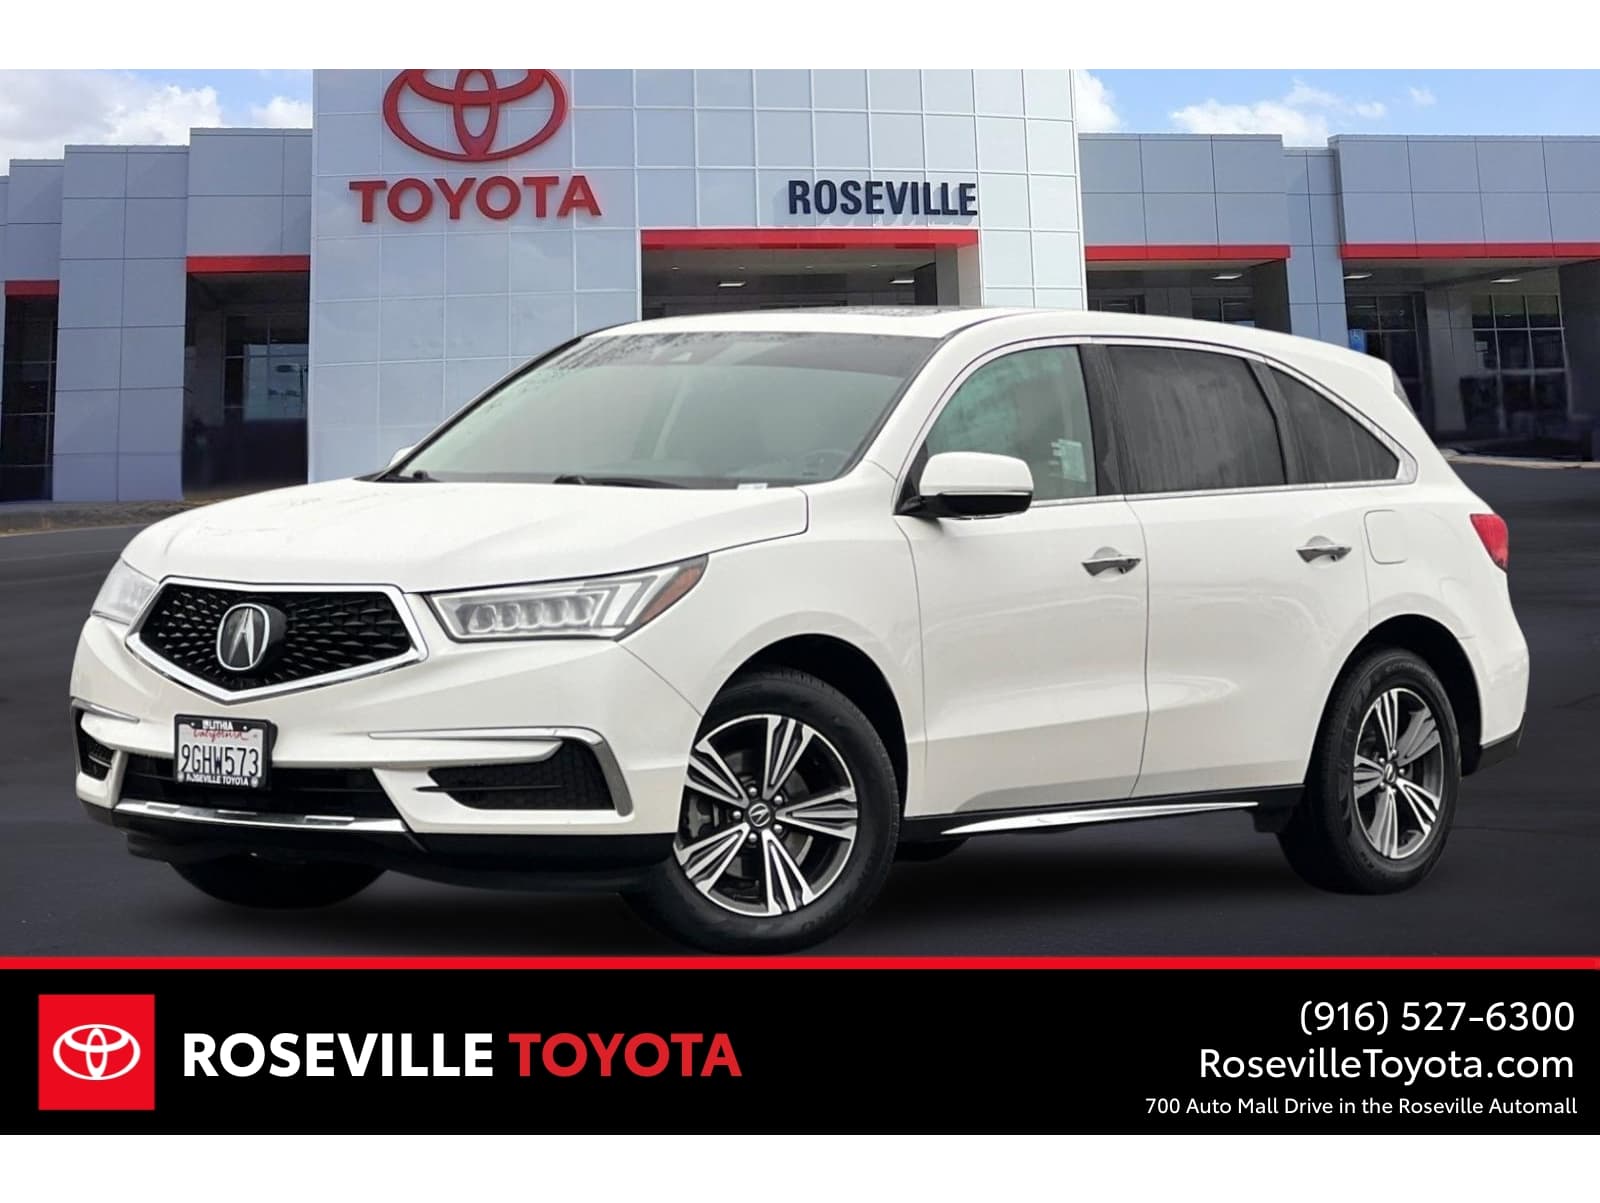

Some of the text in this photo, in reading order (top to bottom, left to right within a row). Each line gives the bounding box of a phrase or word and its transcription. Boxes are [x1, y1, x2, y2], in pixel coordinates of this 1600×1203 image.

[349, 175, 602, 223] TOYOTA
[788, 179, 979, 217] ROSEVILLE
[209, 719, 234, 731] LITHIA
[180, 743, 260, 777] 9GHW573
[222, 776, 249, 787] TOYOTA
